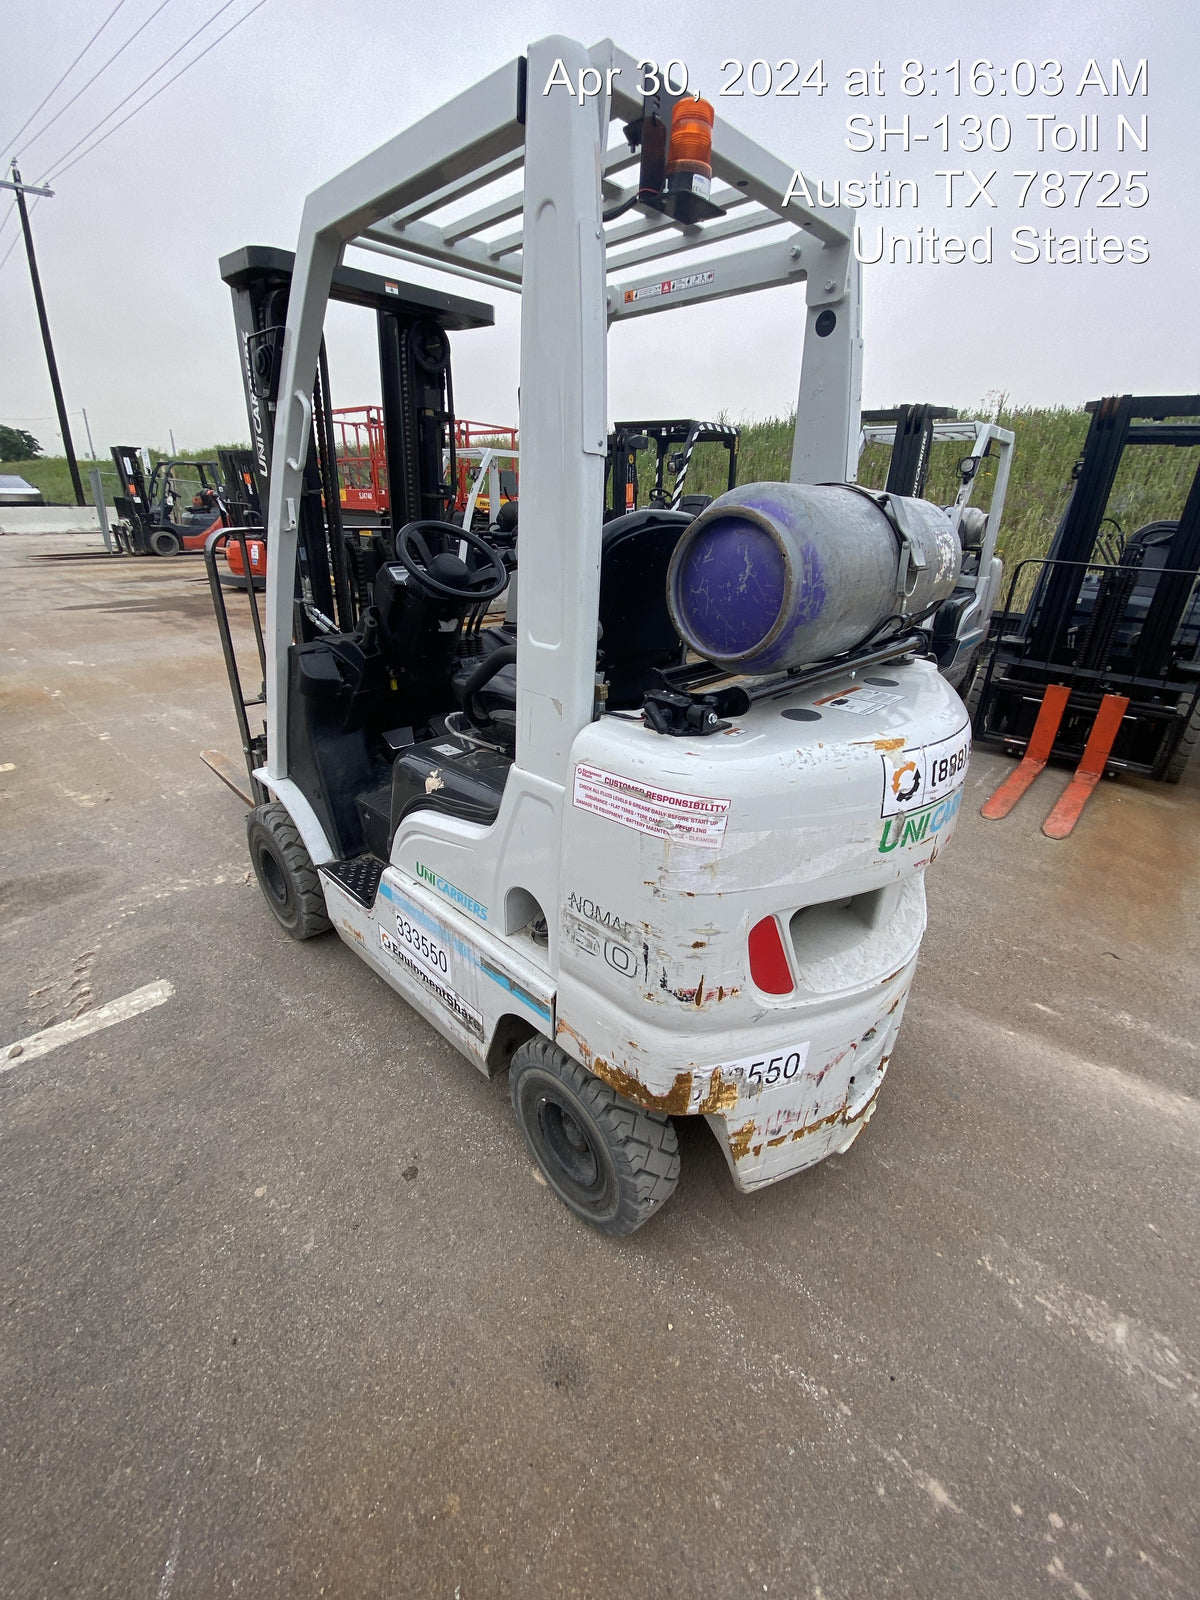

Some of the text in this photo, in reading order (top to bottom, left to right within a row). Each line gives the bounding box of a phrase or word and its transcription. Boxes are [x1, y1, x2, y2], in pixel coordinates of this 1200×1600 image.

[645, 790, 728, 813] RESPONSIBILITY
[415, 861, 489, 921] UNICARRIERS
[396, 914, 448, 974] 333550
